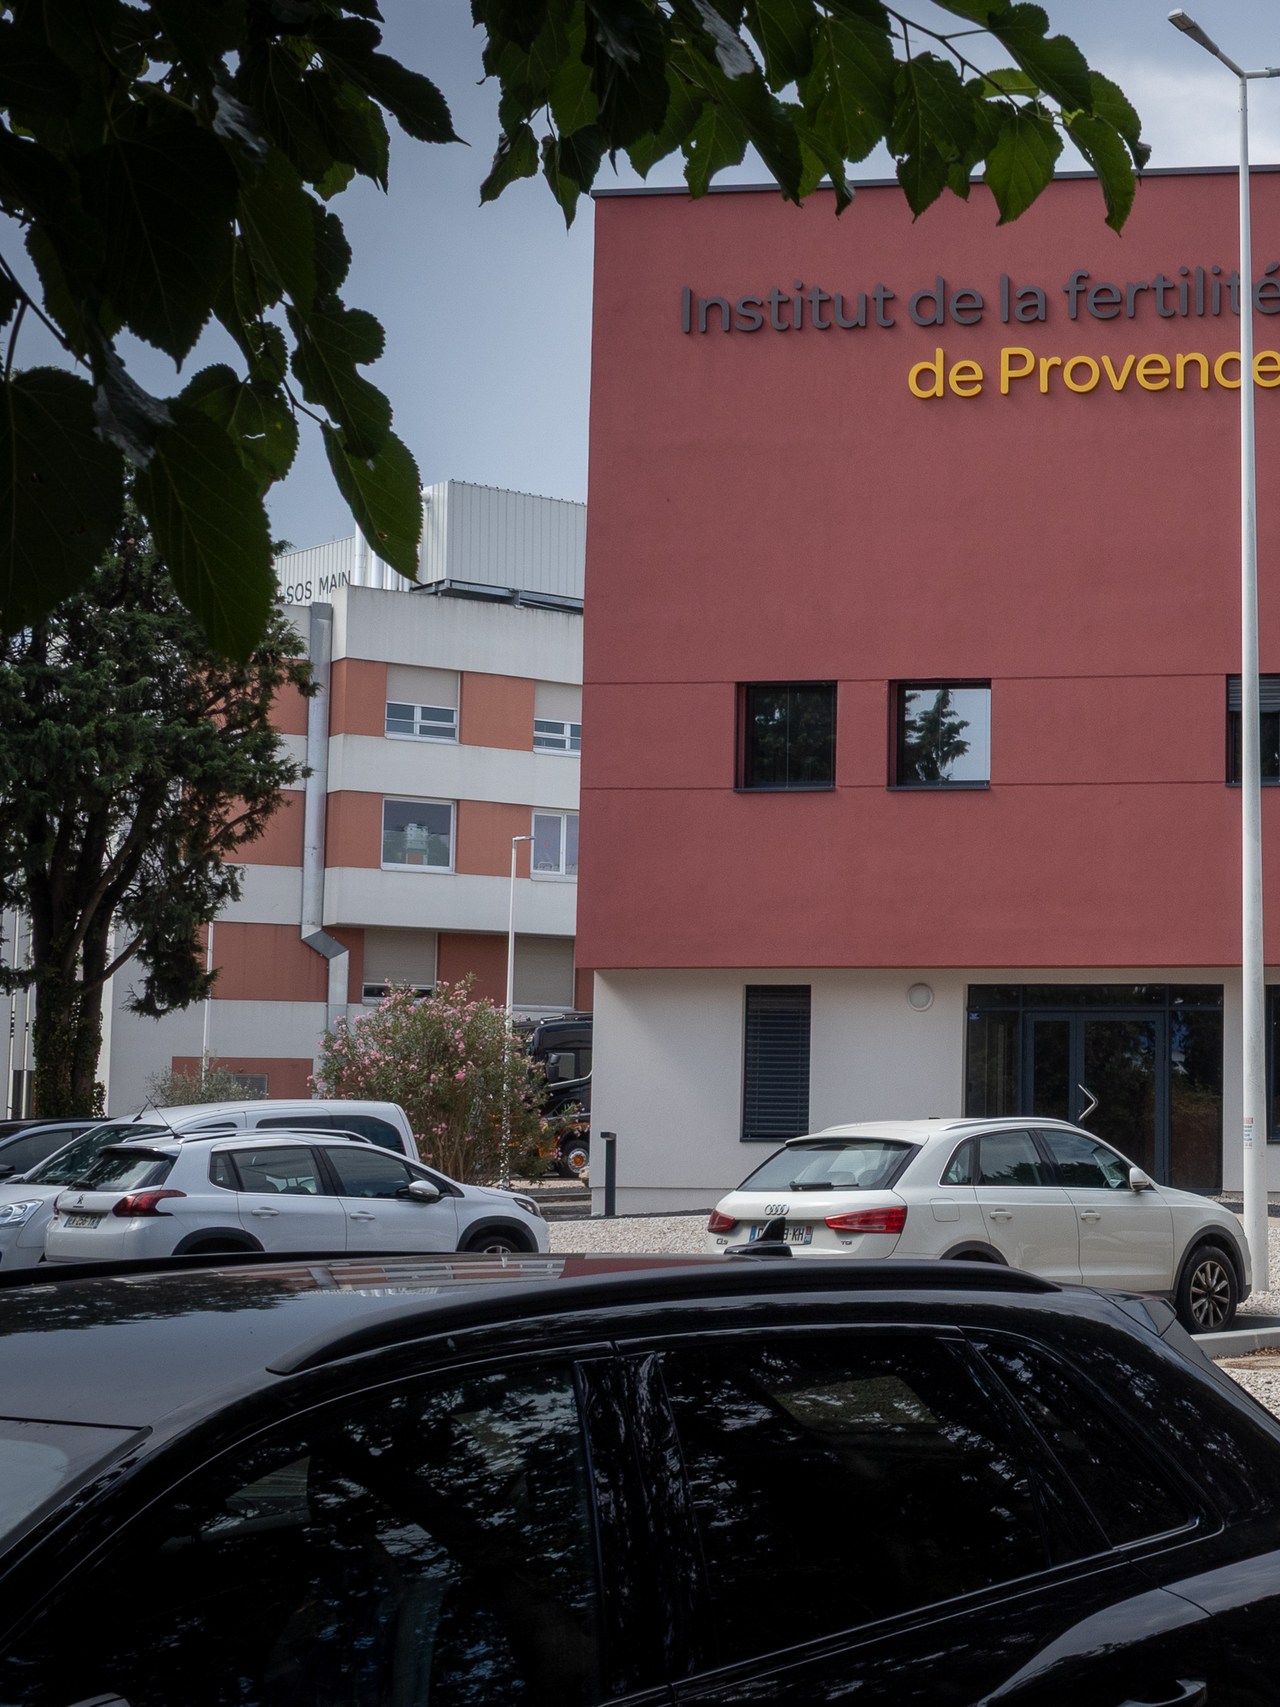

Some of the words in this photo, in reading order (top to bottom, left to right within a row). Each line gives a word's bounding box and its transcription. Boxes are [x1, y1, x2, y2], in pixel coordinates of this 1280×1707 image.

[681, 279, 896, 333] Institut
[908, 274, 985, 327] de
[1001, 272, 1047, 323] la
[908, 347, 984, 399] de
[286, 580, 313, 604] SOS
[319, 569, 351, 596] MAIN
